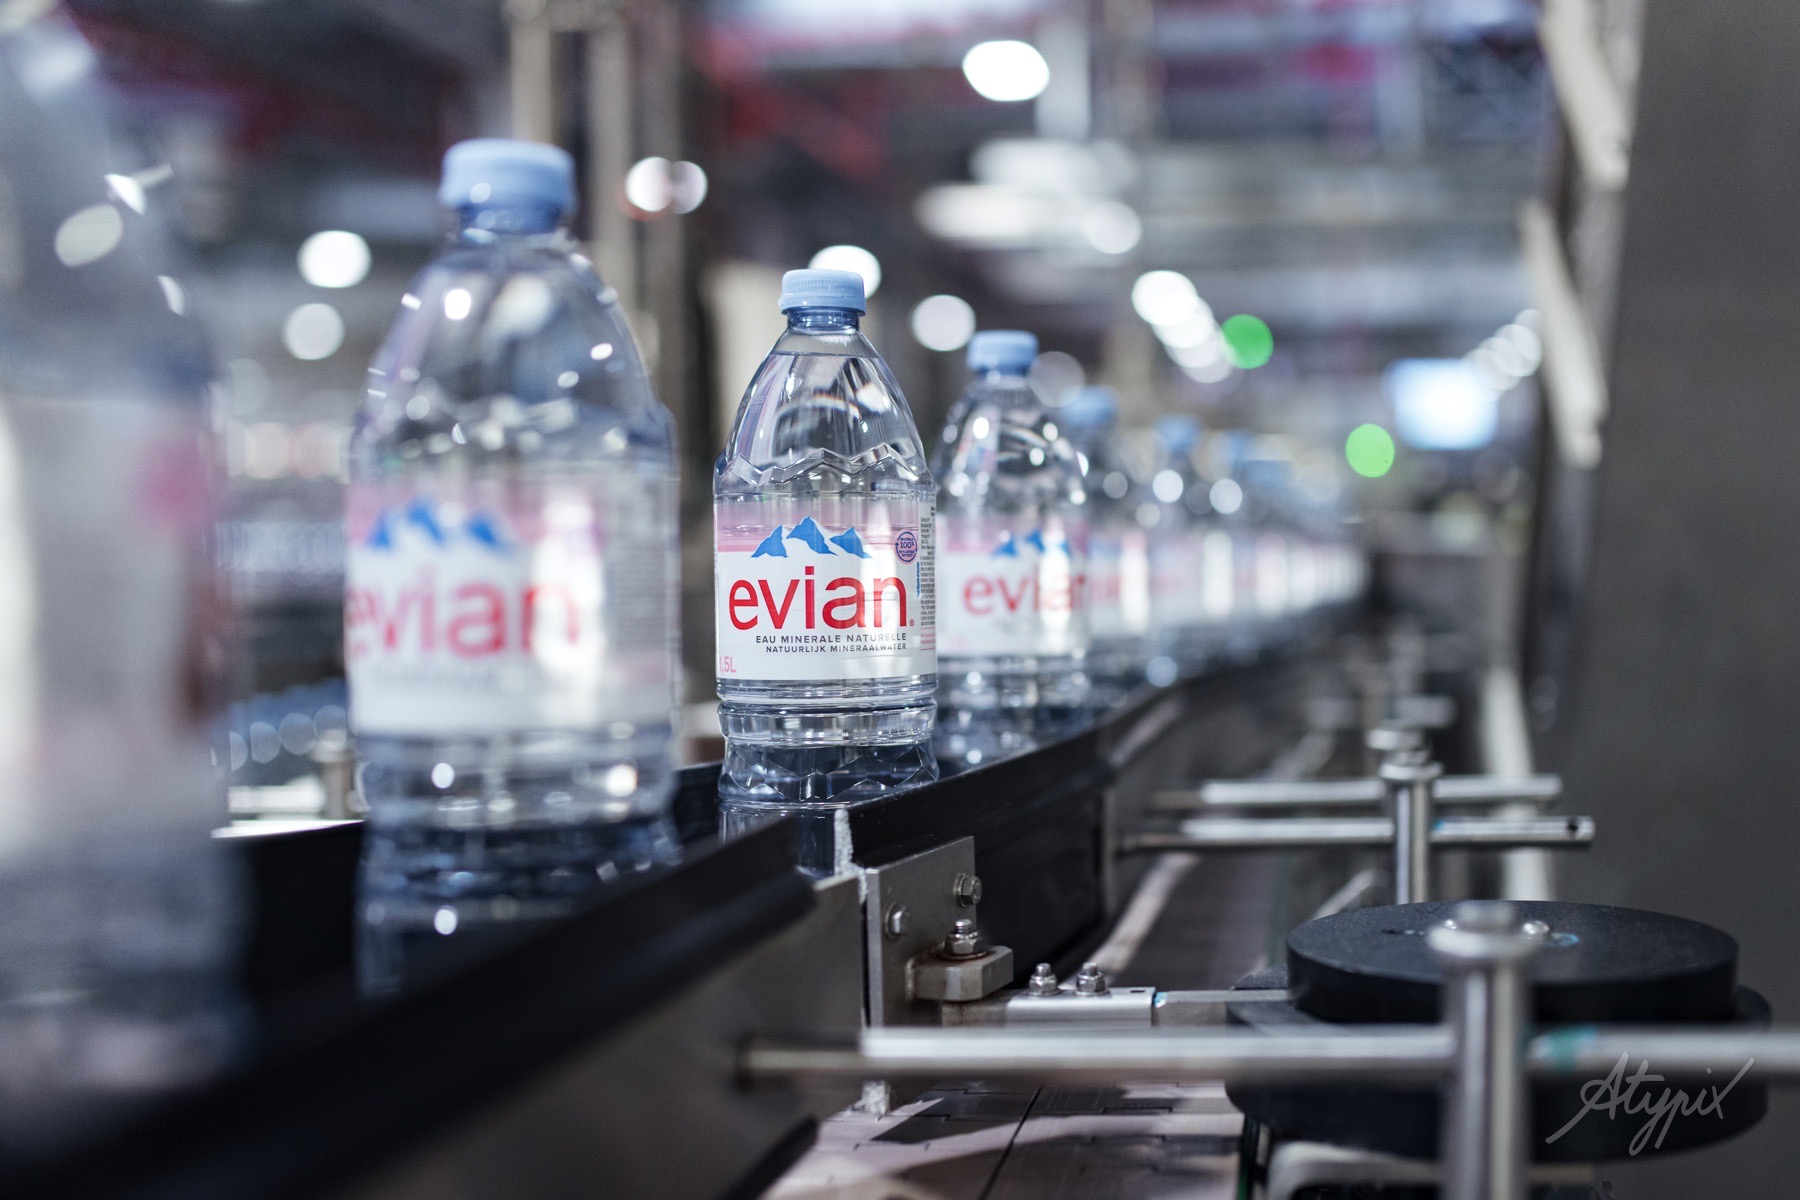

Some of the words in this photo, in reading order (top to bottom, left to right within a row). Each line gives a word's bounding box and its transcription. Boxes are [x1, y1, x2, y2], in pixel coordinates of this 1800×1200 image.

[728, 566, 907, 631] evian
[756, 635, 776, 644] EAU
[781, 634, 841, 644] MINERALE
[846, 633, 907, 643] NATURELLE
[766, 644, 826, 653] NATUURLIJK
[830, 643, 907, 653] MINERAALWATER
